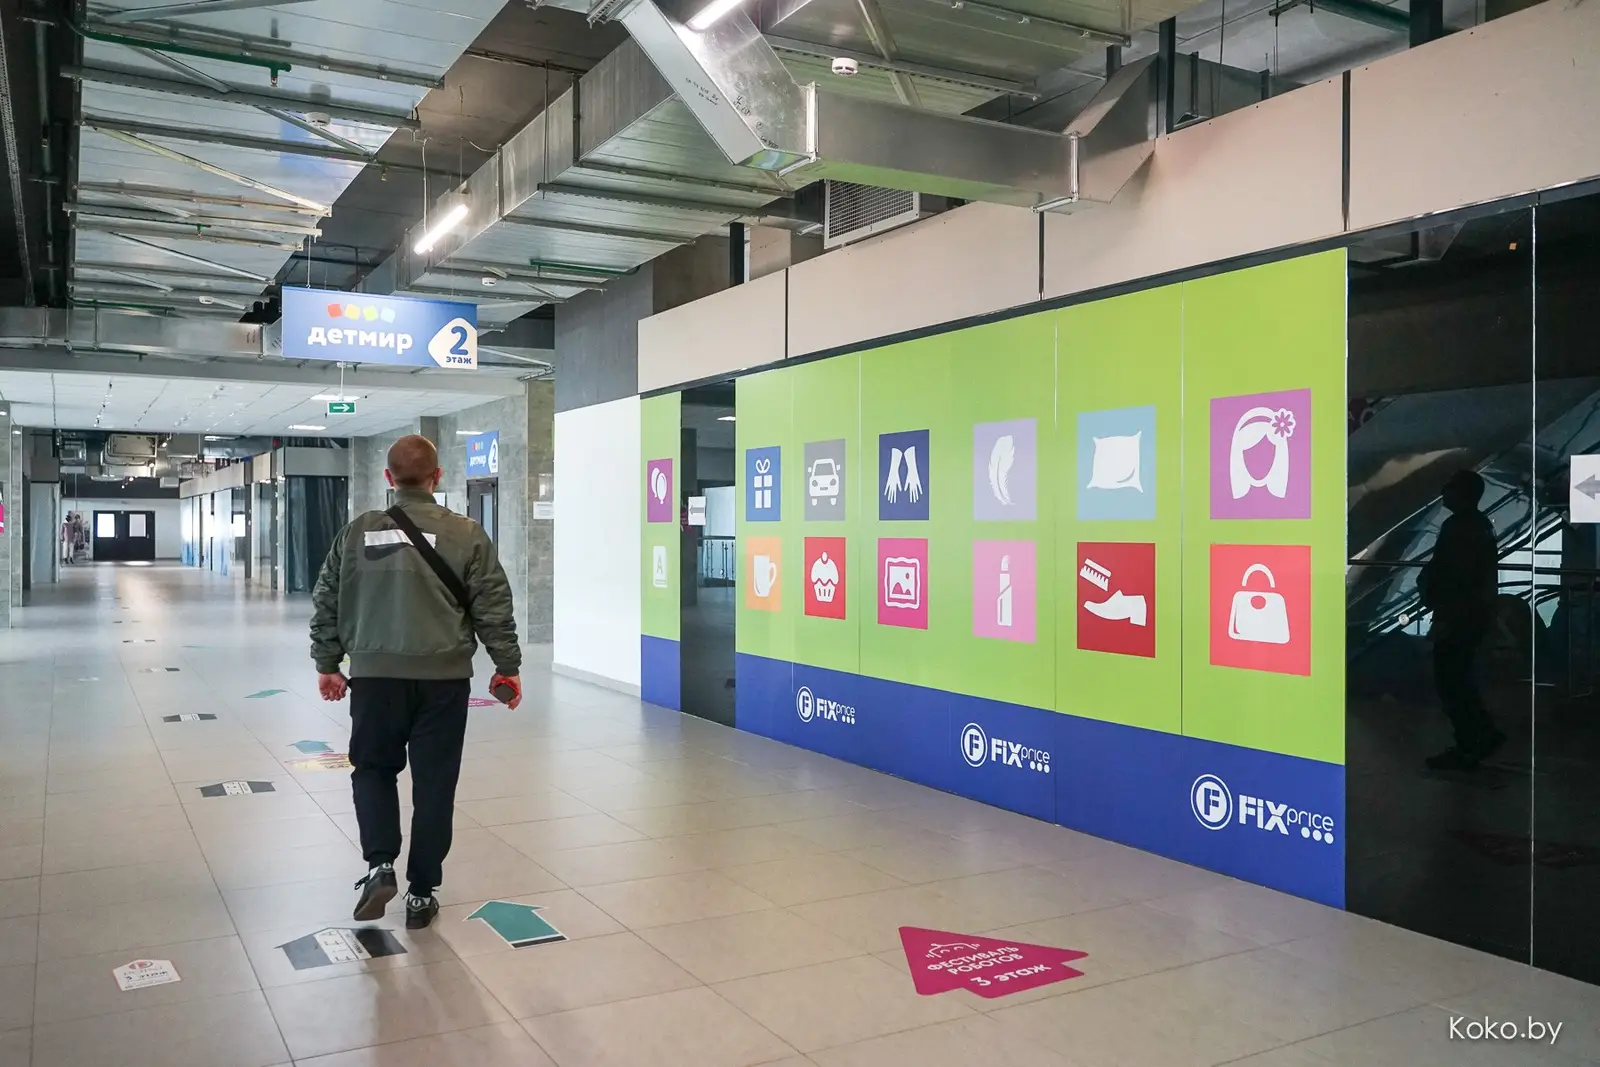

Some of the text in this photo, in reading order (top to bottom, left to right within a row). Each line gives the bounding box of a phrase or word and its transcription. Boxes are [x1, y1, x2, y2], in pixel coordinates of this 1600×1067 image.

[307, 325, 413, 354] детмир
[450, 325, 468, 355] 2
[445, 356, 472, 364] этаж
[491, 444, 497, 463] 2
[927, 946, 1019, 970] ФЕСТИВАЛЬ
[947, 953, 1023, 975] РОБОТОВ
[970, 964, 1052, 986] 3 этаж
